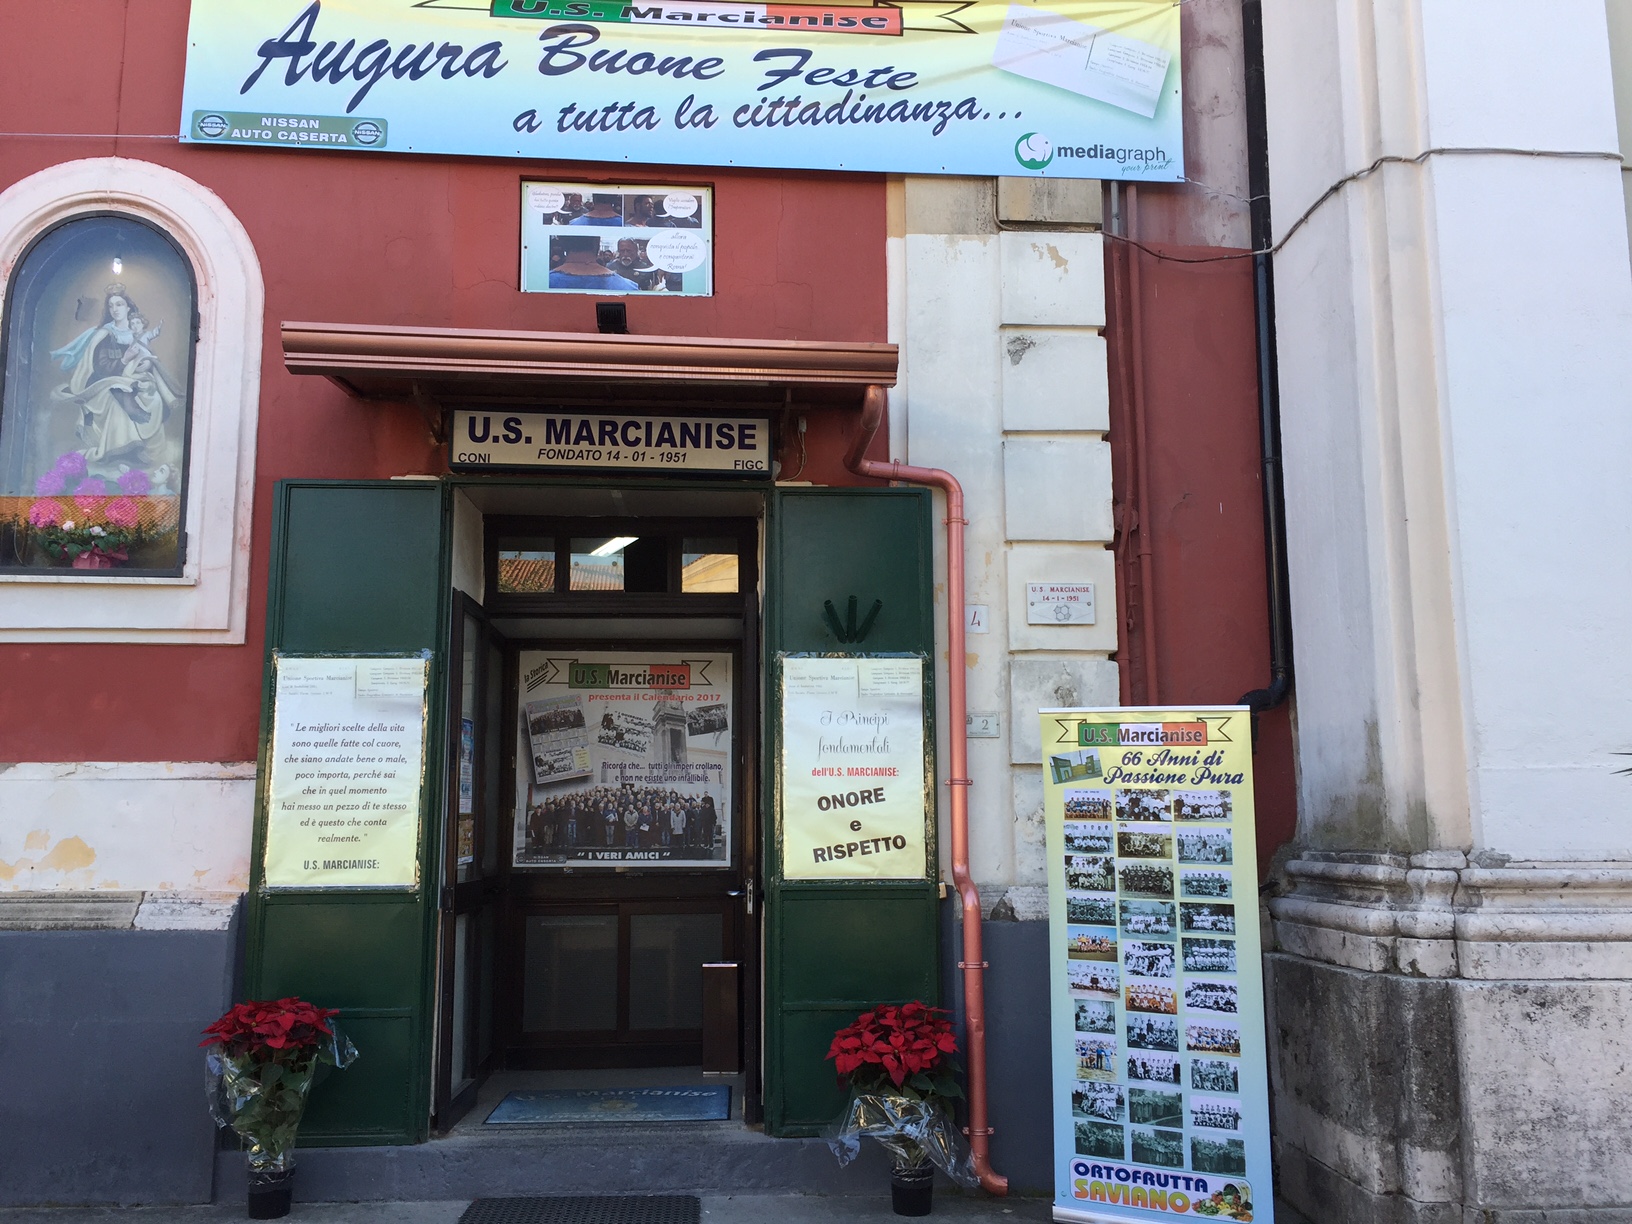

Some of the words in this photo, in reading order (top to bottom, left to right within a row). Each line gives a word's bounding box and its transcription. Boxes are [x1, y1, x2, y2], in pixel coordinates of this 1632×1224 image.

[510, 0, 604, 17] U.S.
[620, 6, 889, 29] Marcianise
[240, 0, 508, 113] Augura
[538, 24, 725, 80] Buone
[753, 48, 919, 91] Feste
[512, 109, 542, 133] a
[557, 101, 661, 133] tutta
[674, 94, 719, 129] la
[733, 89, 1022, 136] cittadinanza...
[261, 117, 320, 129] NISSAN
[231, 129, 273, 140] AUTO
[277, 131, 348, 143] CASERTA
[1057, 144, 1166, 164] mediagraph
[1121, 164, 1141, 176] your
[1142, 158, 1175, 174] print
[467, 416, 533, 444] U.S.
[545, 418, 757, 450] MARCIANISE
[458, 452, 491, 464] CONI
[537, 448, 602, 461] FONDATO
[606, 450, 620, 461] 14
[631, 451, 646, 462] 01
[659, 452, 687, 463] 1951
[733, 459, 764, 470] FIGC
[970, 611, 981, 626] 4
[530, 661, 549, 680] Storica
[574, 669, 602, 685] U.S.
[607, 669, 686, 685] Marcianise
[588, 693, 631, 702] presenta
[633, 693, 640, 701] il
[642, 693, 694, 702] Calendario
[696, 694, 721, 702] 2017
[309, 723, 341, 733] migliori
[342, 723, 366, 732] scelte
[367, 723, 388, 732] della
[389, 723, 405, 732] vita
[837, 710, 890, 734] Principi
[981, 719, 989, 730] 2
[1083, 728, 1113, 743] U.S.
[1117, 728, 1203, 743] Marcianise
[292, 740, 311, 748] sono
[313, 739, 338, 749] quelle
[340, 739, 360, 748] fatte
[362, 739, 374, 748] col
[376, 740, 401, 749] cuore,
[817, 736, 891, 762] fondamentali
[284, 754, 299, 763] che
[301, 755, 323, 763] siano
[325, 755, 354, 763] andate
[356, 754, 376, 763] bene
[385, 754, 408, 764] male,
[1121, 751, 1143, 766] 66
[1146, 749, 1201, 766] Anni
[1203, 750, 1225, 766] di
[602, 761, 627, 770] Ricorda
[648, 762, 663, 770] tutti
[695, 762, 724, 771] crollano,
[811, 767, 845, 777] dell'U.S.
[847, 767, 900, 777] MARCIANISE:
[295, 772, 315, 781] poco
[317, 770, 350, 780] importa,
[353, 769, 382, 781] perché
[383, 770, 396, 779] sai
[644, 774, 663, 782] esiste
[678, 773, 710, 782] infallibile.
[1103, 765, 1187, 785] Passione
[1190, 766, 1244, 785] Pura
[302, 786, 317, 795] che
[318, 787, 327, 795] in
[329, 786, 347, 796] quel
[349, 787, 387, 795] momento
[817, 787, 886, 811] ONORE
[281, 802, 295, 811] hai
[335, 804, 360, 812] pezzo
[362, 802, 370, 811] di
[372, 802, 381, 811] te
[382, 803, 407, 811] stesso
[300, 818, 309, 826] ed
[311, 818, 316, 826] è
[318, 818, 345, 828] questo
[347, 818, 361, 826] che
[363, 818, 387, 826] conta
[850, 820, 862, 832] e
[318, 833, 361, 842] realmente.
[813, 834, 907, 863] RISPETTO
[595, 852, 622, 860] VERI
[625, 852, 660, 860] AMICI
[304, 860, 320, 870] U.S.
[323, 859, 380, 870] MARCIANISE:
[1073, 1162, 1208, 1193] ORTOFRUTTA
[1074, 1178, 1191, 1213] SAVIANO
